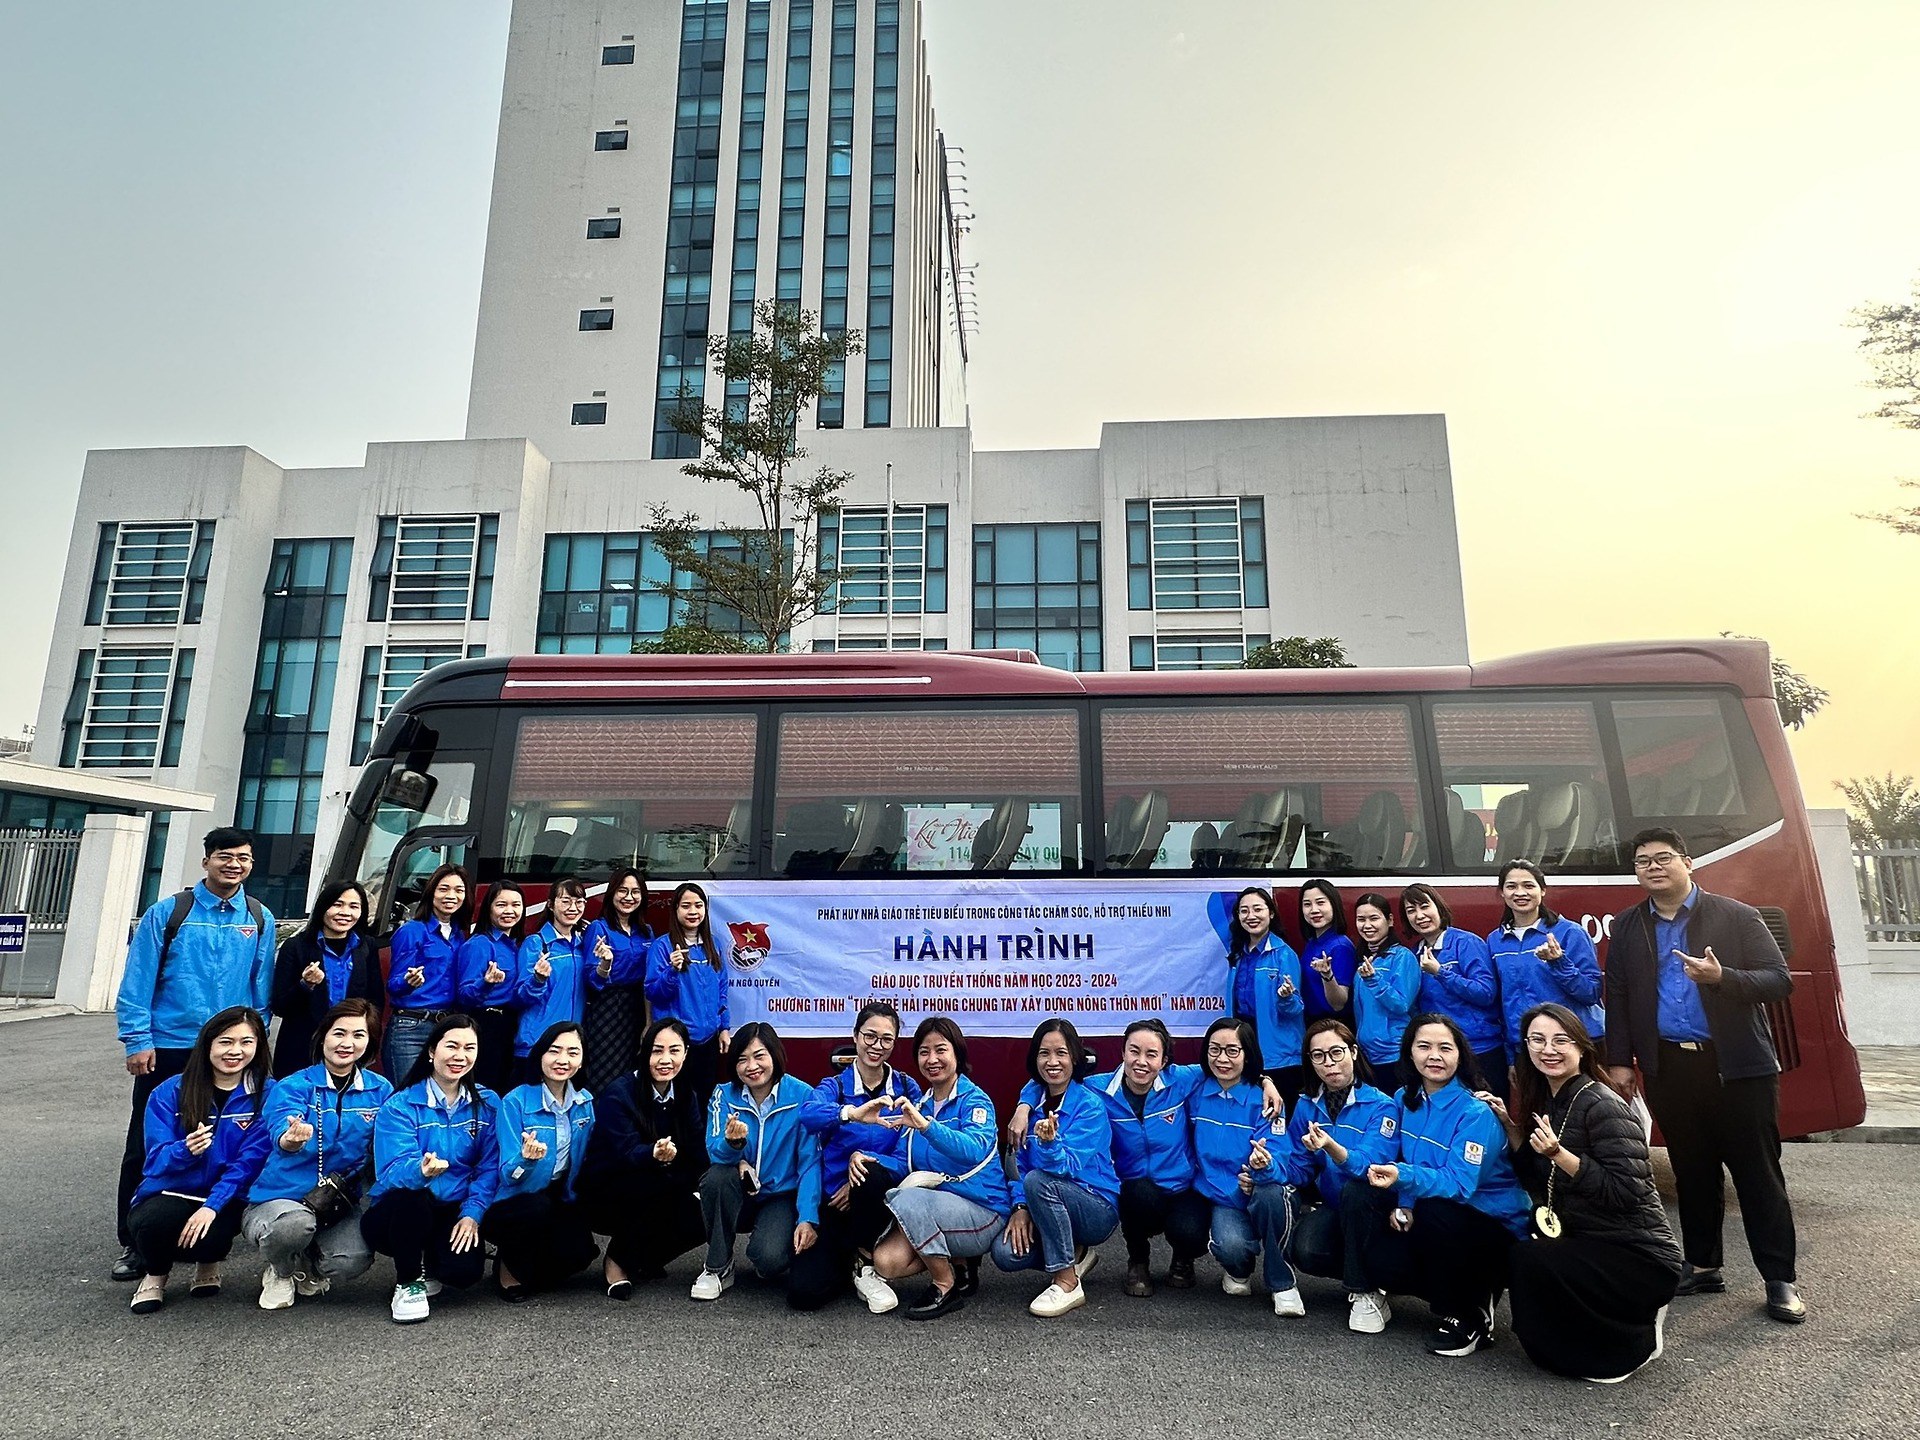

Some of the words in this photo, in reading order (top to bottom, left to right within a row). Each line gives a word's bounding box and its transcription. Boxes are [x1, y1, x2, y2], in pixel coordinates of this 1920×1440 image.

[950, 846, 970, 859] 114
[817, 906, 840, 920] PHÁT
[842, 908, 859, 920] HUY
[861, 906, 879, 920] NHÀ
[881, 906, 902, 920] GIÁO
[904, 904, 920, 919] TRẺ
[922, 906, 941, 919] TIÊU
[943, 903, 964, 919] BIỂU
[966, 907, 995, 919] TRONG
[997, 905, 1022, 919] CÔNG
[1024, 905, 1041, 919] TÁC
[1043, 905, 1069, 918] CHĂM
[1071, 904, 1092, 919] SÓC,
[1094, 902, 1106, 918] HỖ
[1108, 905, 1125, 920] TRỢ
[1127, 902, 1153, 917] THIẾU
[1155, 905, 1171, 917] NHI
[894, 928, 987, 961] HÀNH
[997, 927, 1094, 960] TRÌNH
[736, 977, 752, 987] NGÔ
[754, 976, 780, 988] QUYỀN
[871, 972, 896, 988] GIÁO
[899, 974, 920, 991] DỤC
[923, 970, 963, 988] TRUYỀN
[966, 969, 1000, 988] THỐNG
[1004, 971, 1028, 988] NĂM
[1031, 974, 1052, 990] HỌC
[1055, 974, 1081, 987] 2023
[1091, 974, 1117, 987] 2024
[768, 997, 811, 1012] CHƯƠNG
[813, 996, 845, 1012] TRÌNH
[902, 994, 919, 1012] HẢI
[922, 995, 959, 1012] PHÒNG
[961, 998, 998, 1012] CHUNG
[1000, 997, 1018, 1011] TAY
[1020, 994, 1041, 1011] XÂY
[1044, 997, 1074, 1014] DỰNG
[1076, 994, 1107, 1011] NÔNG
[1109, 994, 1138, 1011] THÔN
[1171, 994, 1196, 1010] NĂM
[1199, 997, 1225, 1010] 2024
